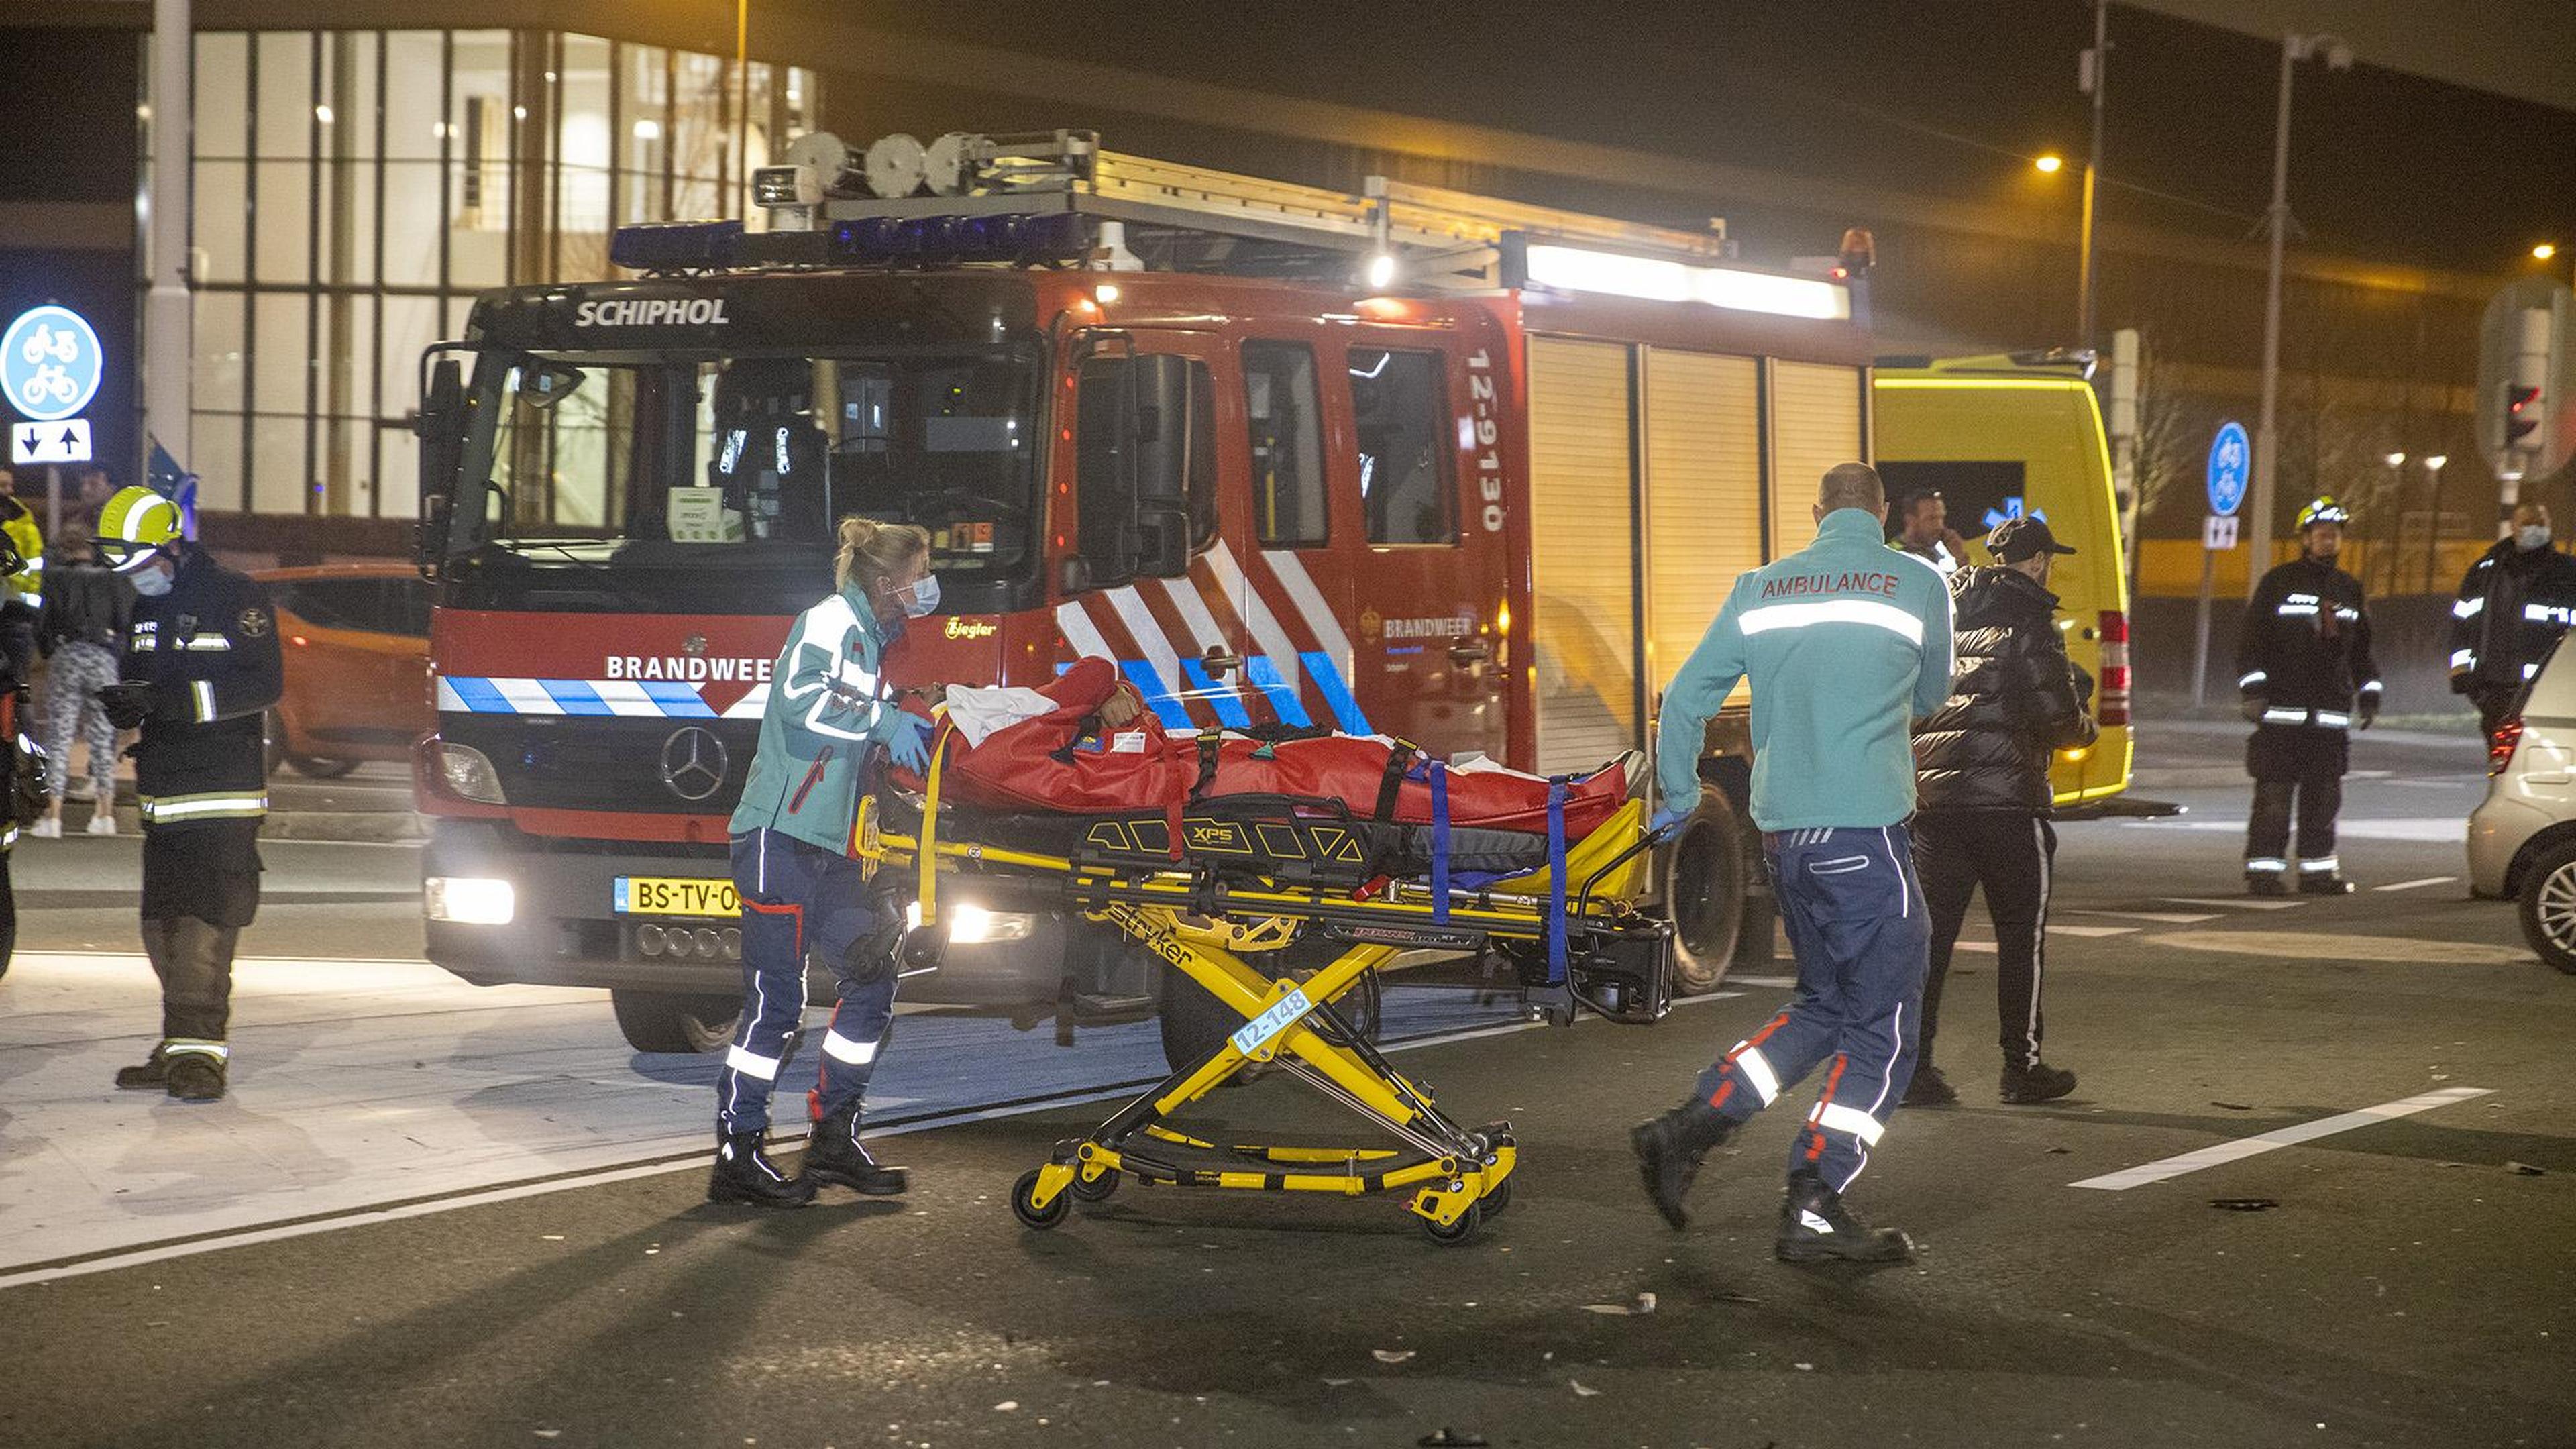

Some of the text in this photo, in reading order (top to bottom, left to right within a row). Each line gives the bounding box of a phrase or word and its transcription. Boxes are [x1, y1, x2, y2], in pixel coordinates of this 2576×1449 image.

[575, 299, 729, 327] SCHIPHOL
[1468, 348, 1503, 531] 12-9130
[1762, 572, 1898, 598] AMBULANCE
[1385, 617, 1472, 637] BRANDWEER
[607, 656, 778, 681] BRANDWEE
[1193, 827, 1233, 841] XPS
[639, 883, 741, 910] BS-TV-0
[1236, 991, 1306, 1048] 12-148
